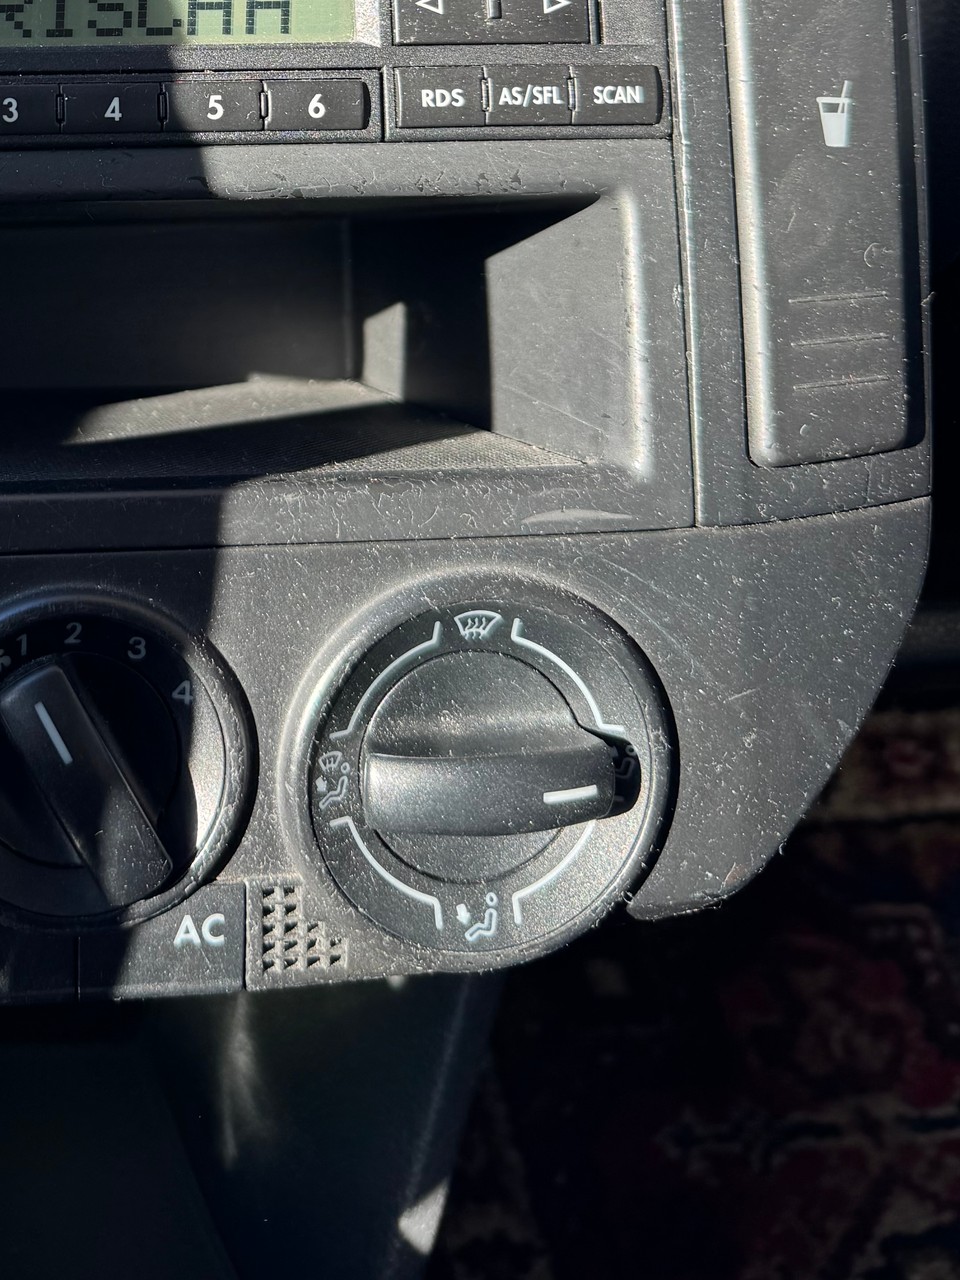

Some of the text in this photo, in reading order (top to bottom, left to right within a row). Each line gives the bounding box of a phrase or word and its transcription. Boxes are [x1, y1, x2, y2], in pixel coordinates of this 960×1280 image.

[308, 94, 326, 118] 6
[421, 89, 465, 108] RDS
[498, 84, 563, 107] AS/SFL
[593, 86, 644, 105] SCAN
[2, 98, 19, 122] 3
[105, 97, 123, 121] 4
[207, 96, 224, 119] 5
[15, 633, 28, 656] 1
[64, 623, 82, 644] 2
[127, 636, 147, 660] 3
[171, 679, 194, 705] 4
[174, 914, 225, 946] AC
